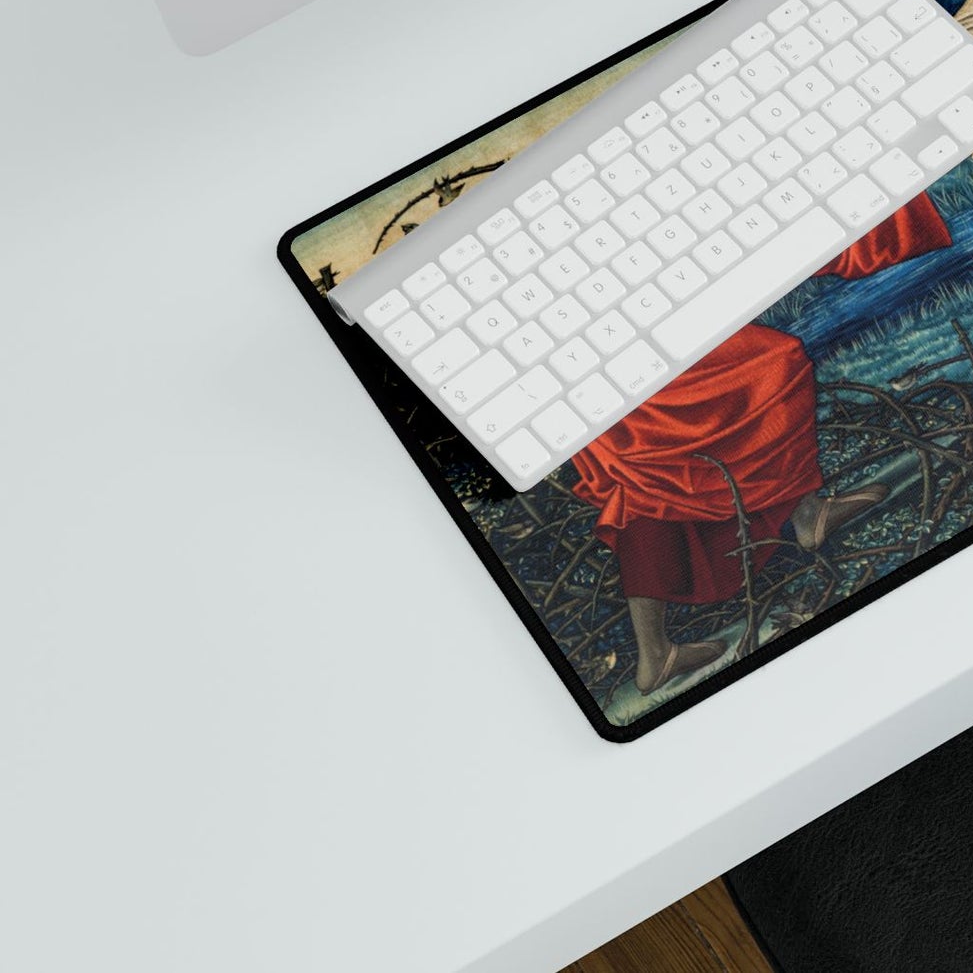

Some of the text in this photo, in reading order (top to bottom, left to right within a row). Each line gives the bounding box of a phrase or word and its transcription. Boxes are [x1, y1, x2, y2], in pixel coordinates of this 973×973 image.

[746, 68, 756, 77] 0
[804, 81, 814, 92] P
[711, 93, 721, 103] 9
[770, 107, 783, 118] O
[676, 119, 687, 129] 8
[804, 126, 817, 136] L
[640, 144, 650, 155] 7
[768, 150, 783, 162] K
[700, 157, 713, 169] U
[607, 171, 617, 180] 6
[736, 177, 746, 187] J
[665, 184, 678, 196] Z
[570, 196, 581, 207] 5
[780, 191, 795, 204] M
[698, 201, 713, 214] H
[630, 210, 641, 221] T
[537, 222, 546, 232] 4
[745, 217, 759, 230] N
[664, 229, 676, 240] G
[594, 237, 607, 248] R
[499, 249, 510, 259] 3
[710, 245, 723, 256] B
[628, 255, 638, 267] F
[559, 263, 572, 275] E
[463, 275, 474, 286] 2
[674, 270, 686, 281] V
[592, 282, 605, 294] D
[520, 288, 536, 302] W
[426, 303, 436, 312] 1
[640, 297, 652, 309] C
[556, 309, 568, 320] S
[486, 317, 500, 328] Q
[602, 323, 617, 337] X
[522, 336, 534, 348] A
[566, 351, 578, 362] Y
